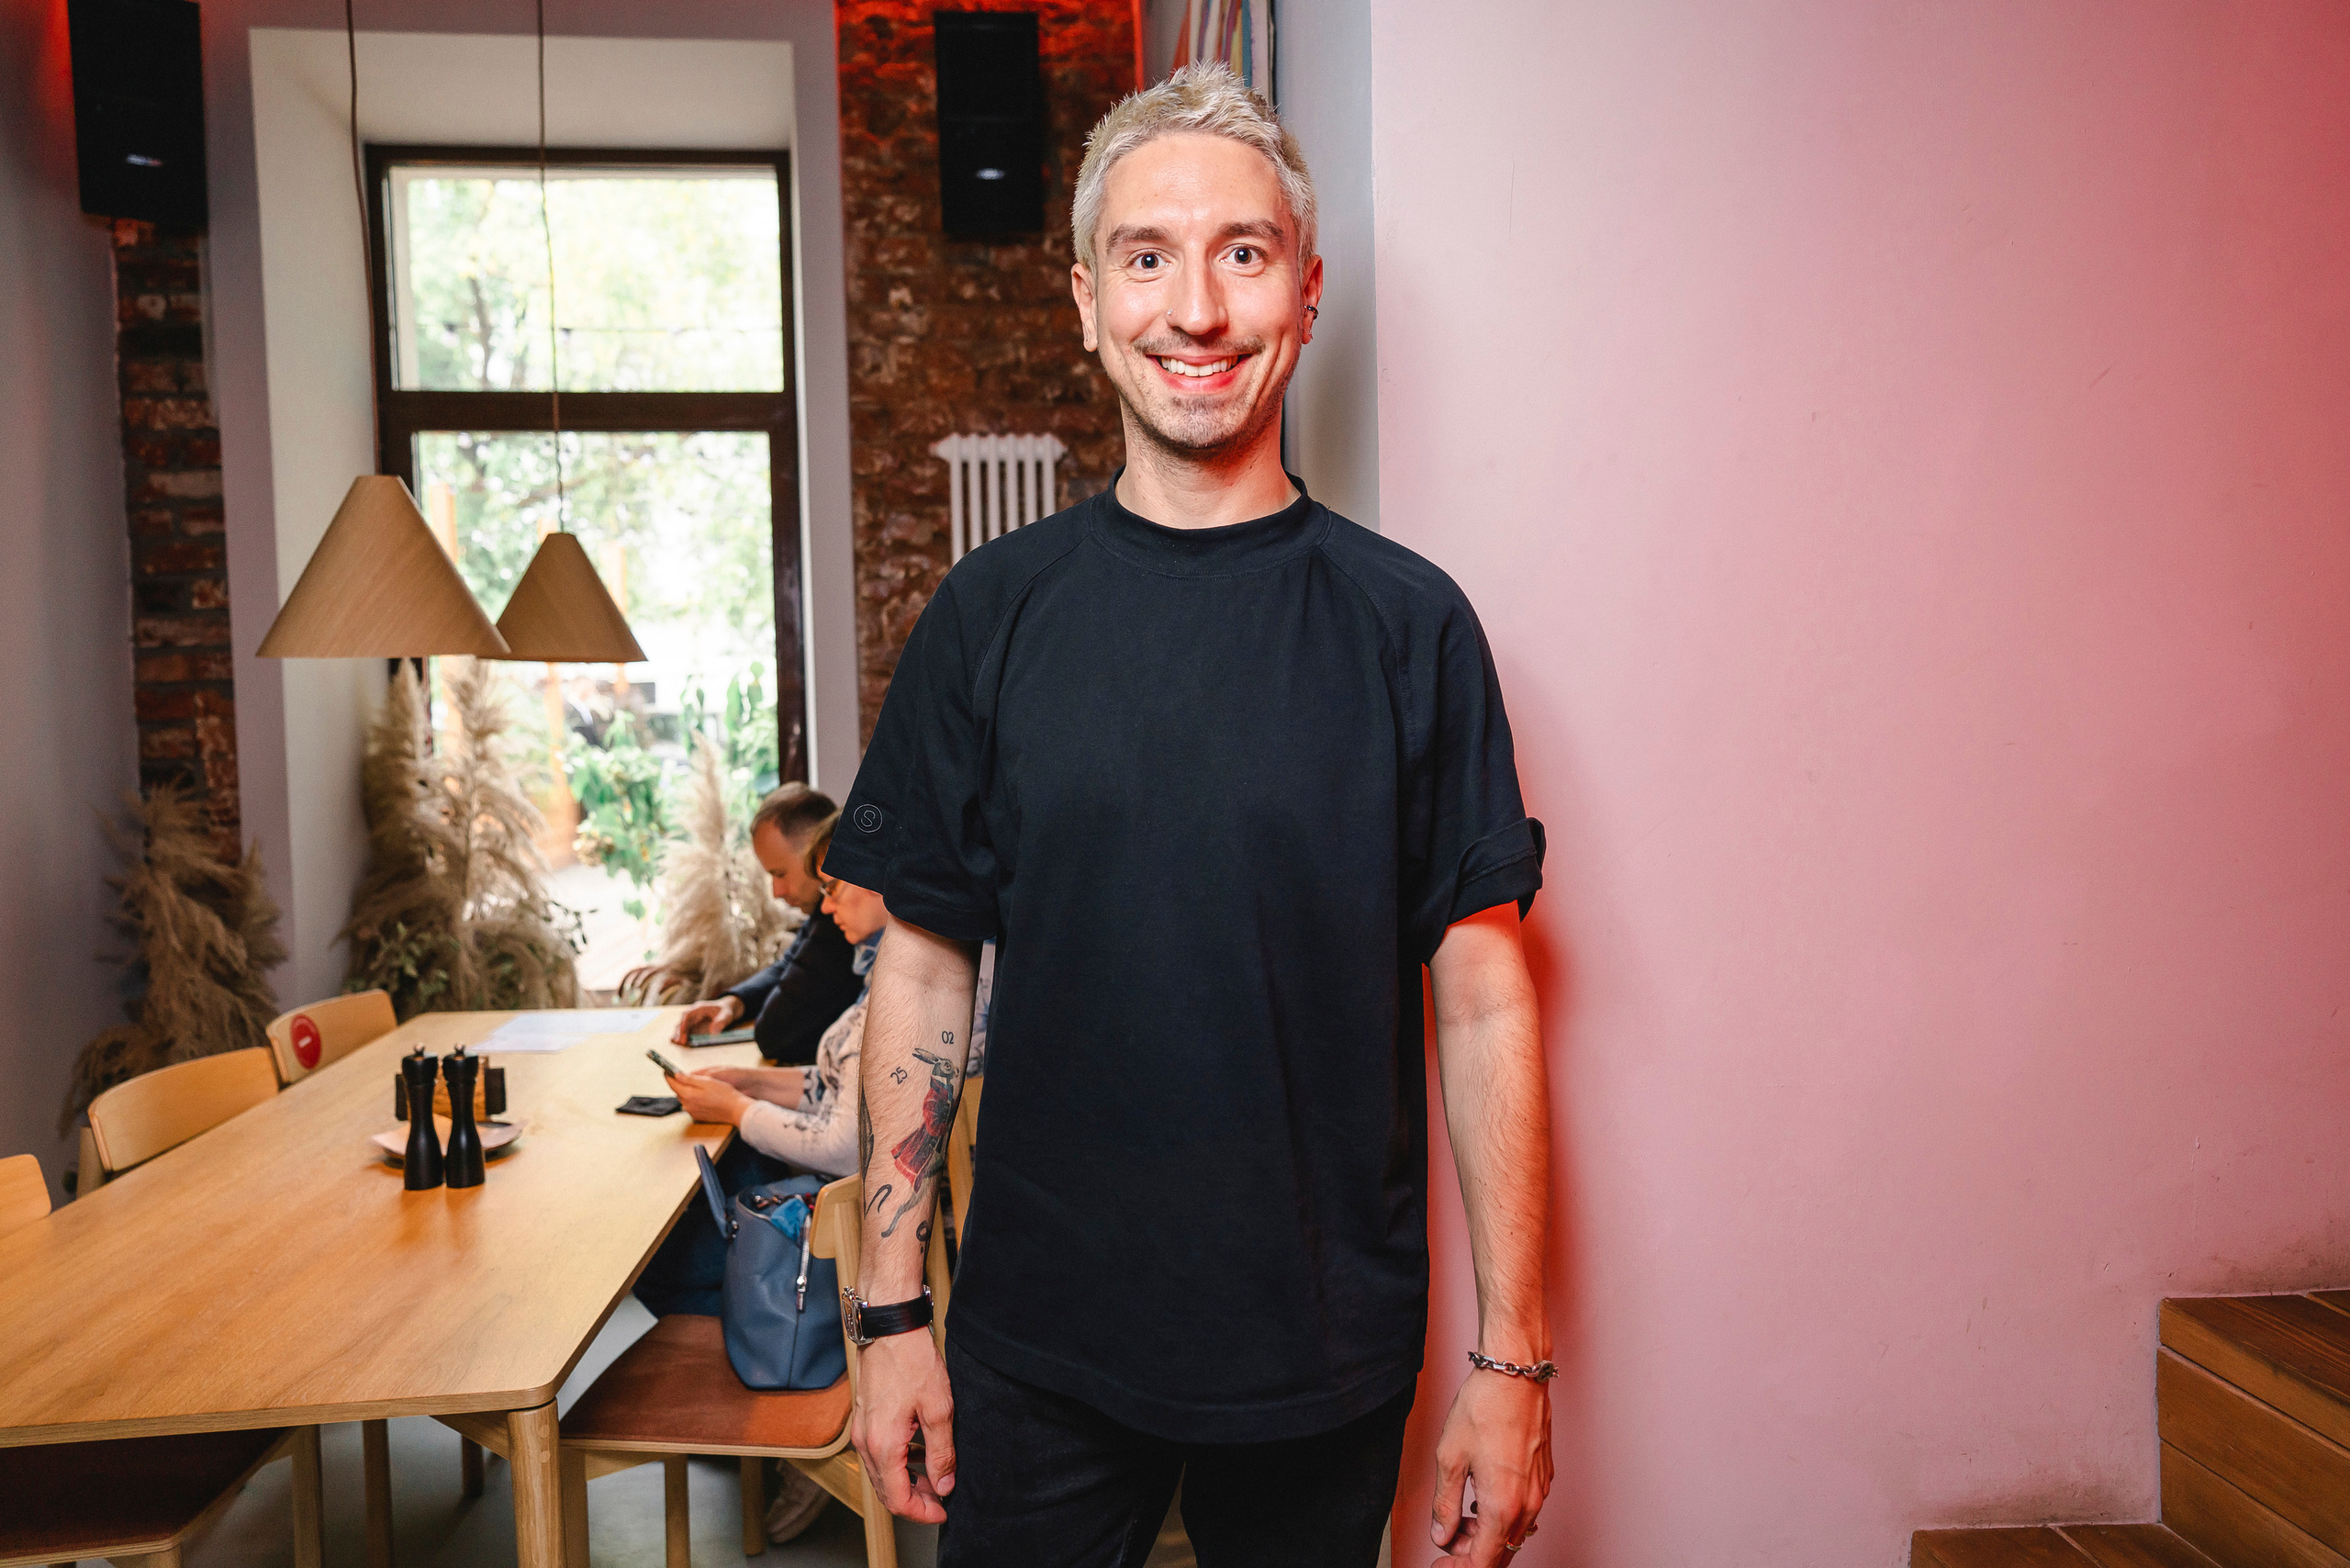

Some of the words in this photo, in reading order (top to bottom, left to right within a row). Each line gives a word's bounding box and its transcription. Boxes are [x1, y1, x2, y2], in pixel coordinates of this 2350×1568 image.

[860, 810, 876, 827] S
[941, 1030, 955, 1045] 02
[890, 1066, 908, 1085] 25
